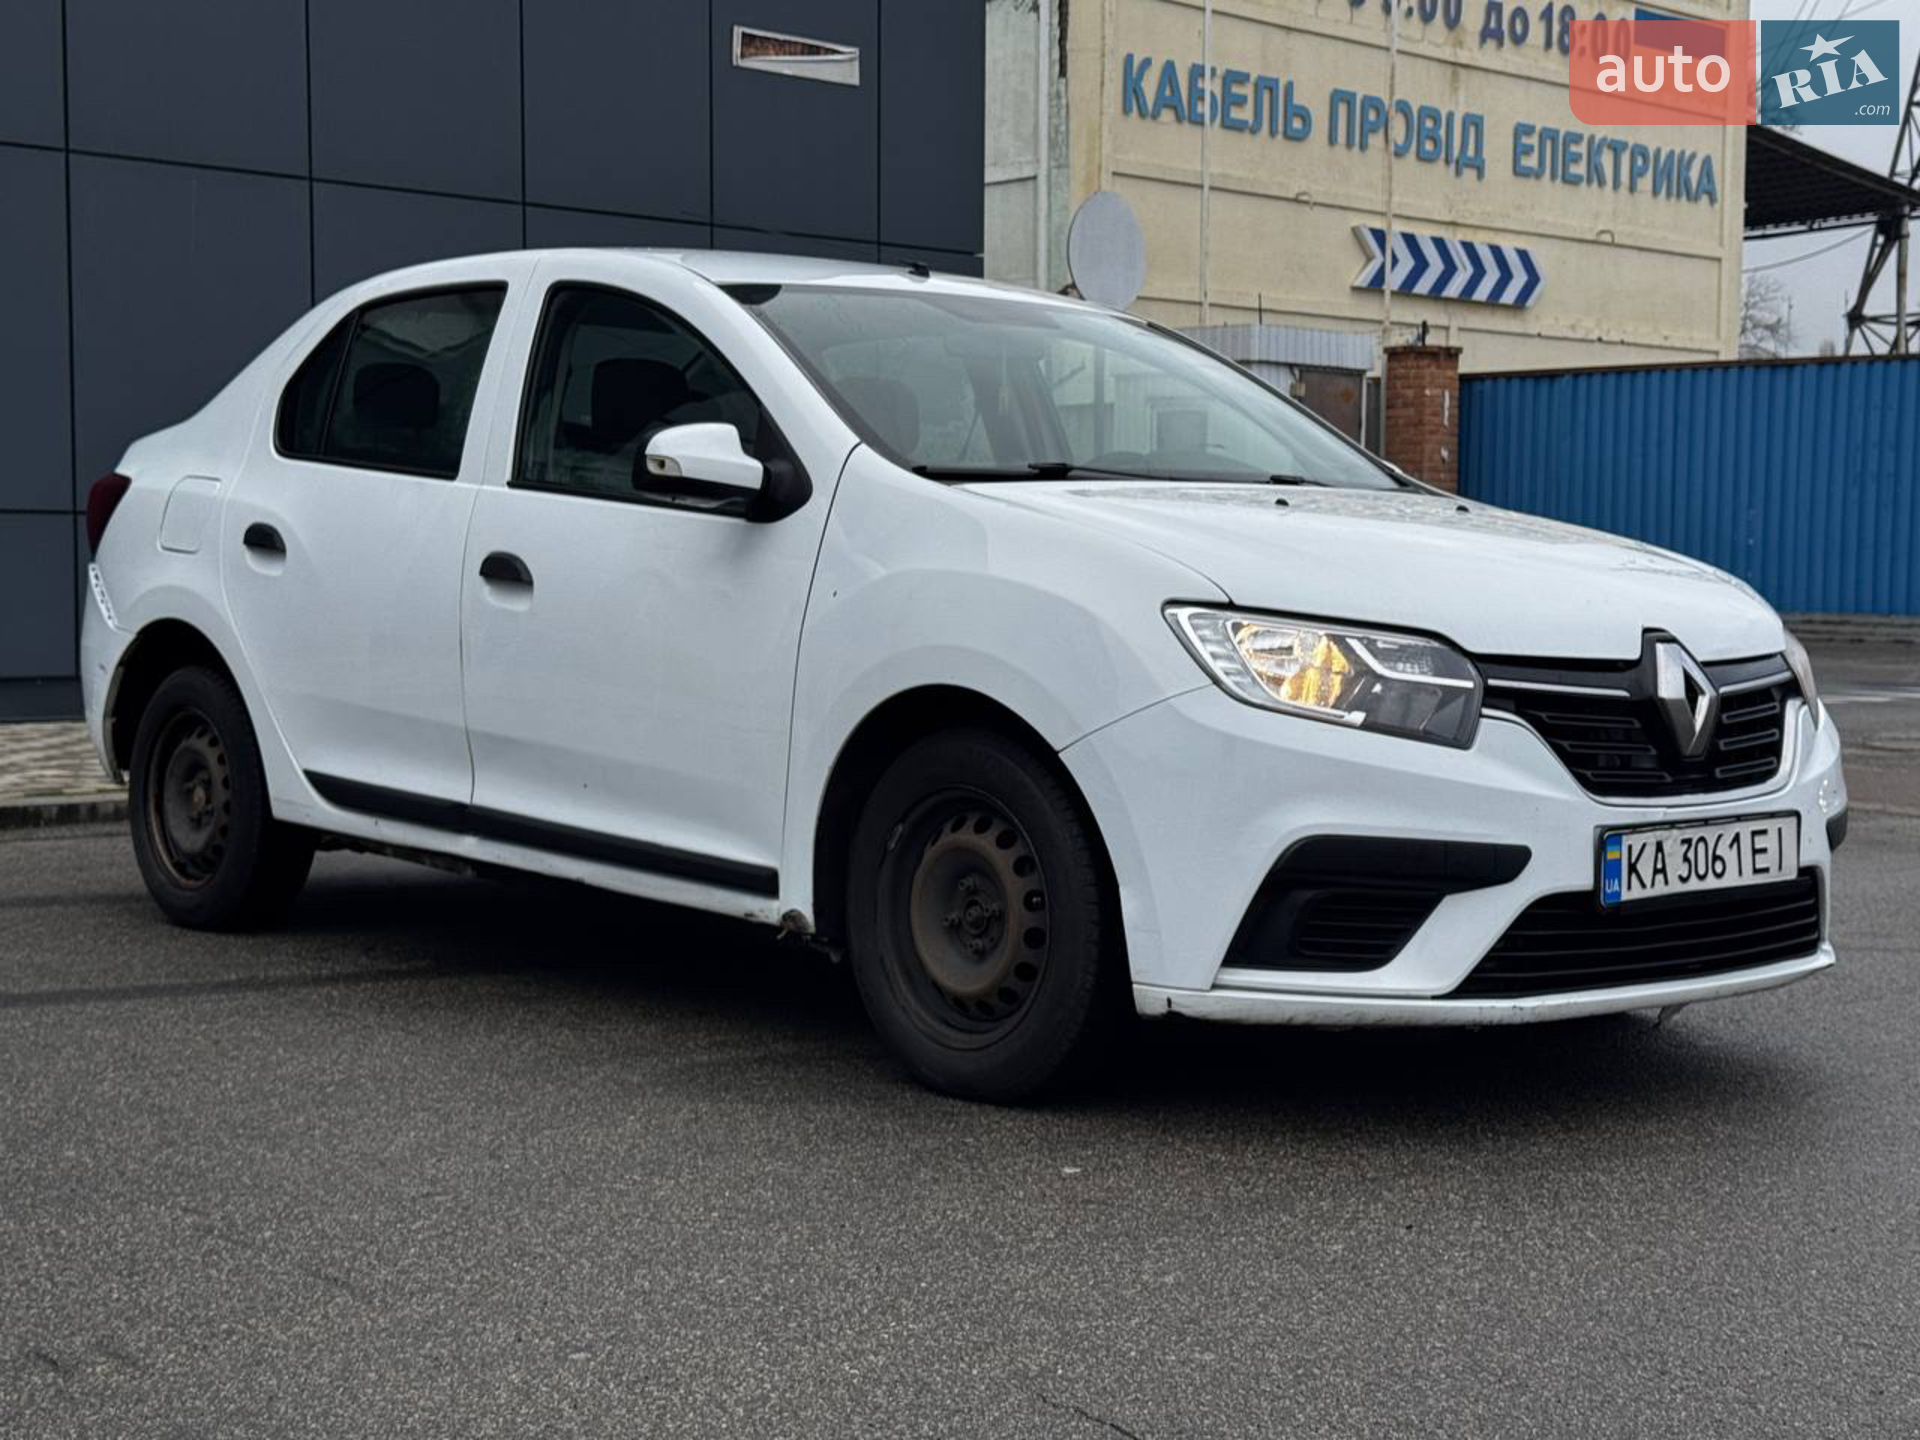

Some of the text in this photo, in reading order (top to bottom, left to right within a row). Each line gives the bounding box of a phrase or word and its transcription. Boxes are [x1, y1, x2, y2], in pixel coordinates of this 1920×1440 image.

[1479, 0, 1530, 49] до
[1122, 53, 1718, 207] КАБЕЛЬ ПРОВІД ЕЛЕКТРИКА
[1605, 878, 1620, 893] UA
[1626, 827, 1783, 892] KA 3061 EI
